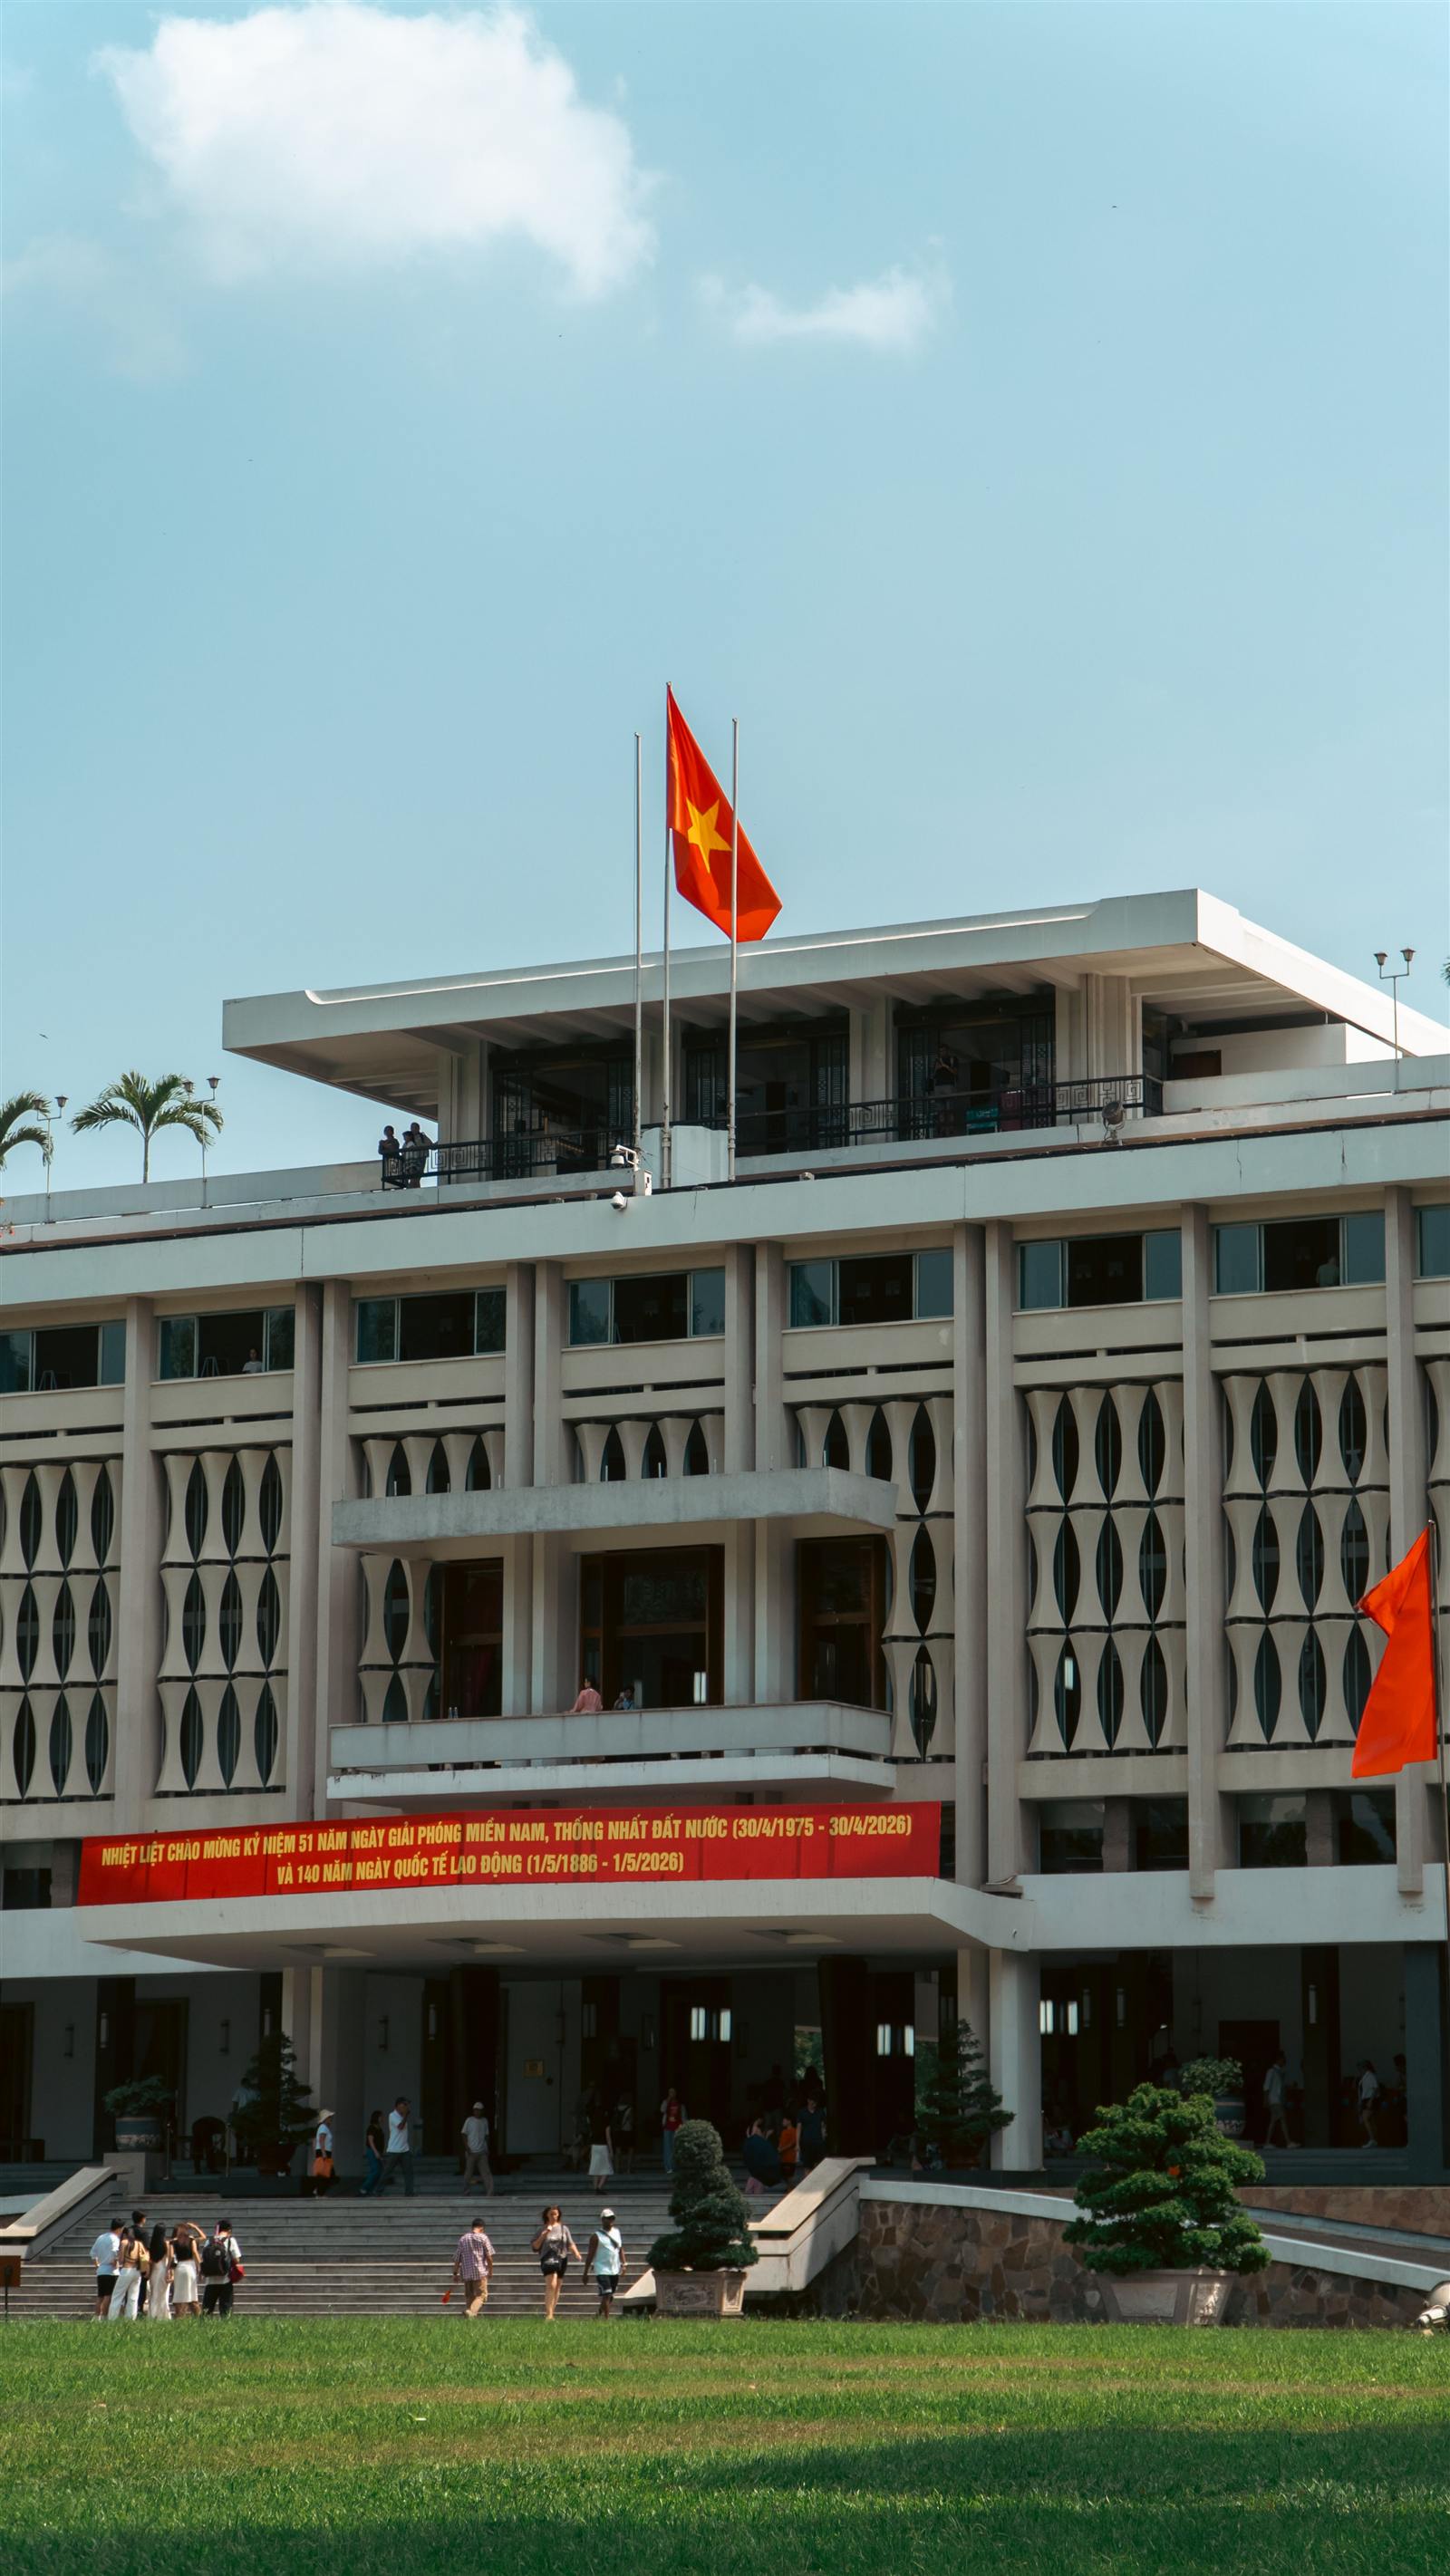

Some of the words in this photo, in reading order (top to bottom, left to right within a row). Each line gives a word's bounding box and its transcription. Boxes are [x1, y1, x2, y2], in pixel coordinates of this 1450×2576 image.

[102, 1843, 138, 1868] NHIỆT
[139, 1841, 165, 1867] LIỆT
[167, 1838, 200, 1861] CHÀO
[203, 1836, 240, 1859] MỪNG
[243, 1831, 259, 1856] KỶ
[263, 1832, 295, 1857] NIỆM
[298, 1834, 314, 1852] 51
[317, 1828, 348, 1851] NĂM
[351, 1826, 385, 1849] NGÀY
[388, 1821, 414, 1846] GIẢI
[417, 1821, 462, 1845] PHÓNG
[465, 1817, 505, 1842] MIỀN
[508, 1822, 549, 1843] NAM,
[554, 1815, 604, 1840] THỐNG
[607, 1814, 648, 1840] NHẤT
[652, 1813, 682, 1838] ĐẤT
[685, 1816, 728, 1838] NƯỚC
[732, 1818, 814, 1839] (30/4/1975
[828, 1815, 913, 1836] 30/4/2026)
[277, 1862, 294, 1885] VÀ
[297, 1867, 320, 1884] 140
[323, 1860, 353, 1882] NĂM
[355, 1857, 391, 1881] NGÀY
[393, 1851, 429, 1880] QUỐC
[431, 1850, 449, 1876] TẾ
[450, 1855, 477, 1875] LAO
[480, 1851, 522, 1877] ĐỘNG
[527, 1854, 598, 1876] (1/5/1886
[613, 1851, 684, 1873] 1/5/2026)
